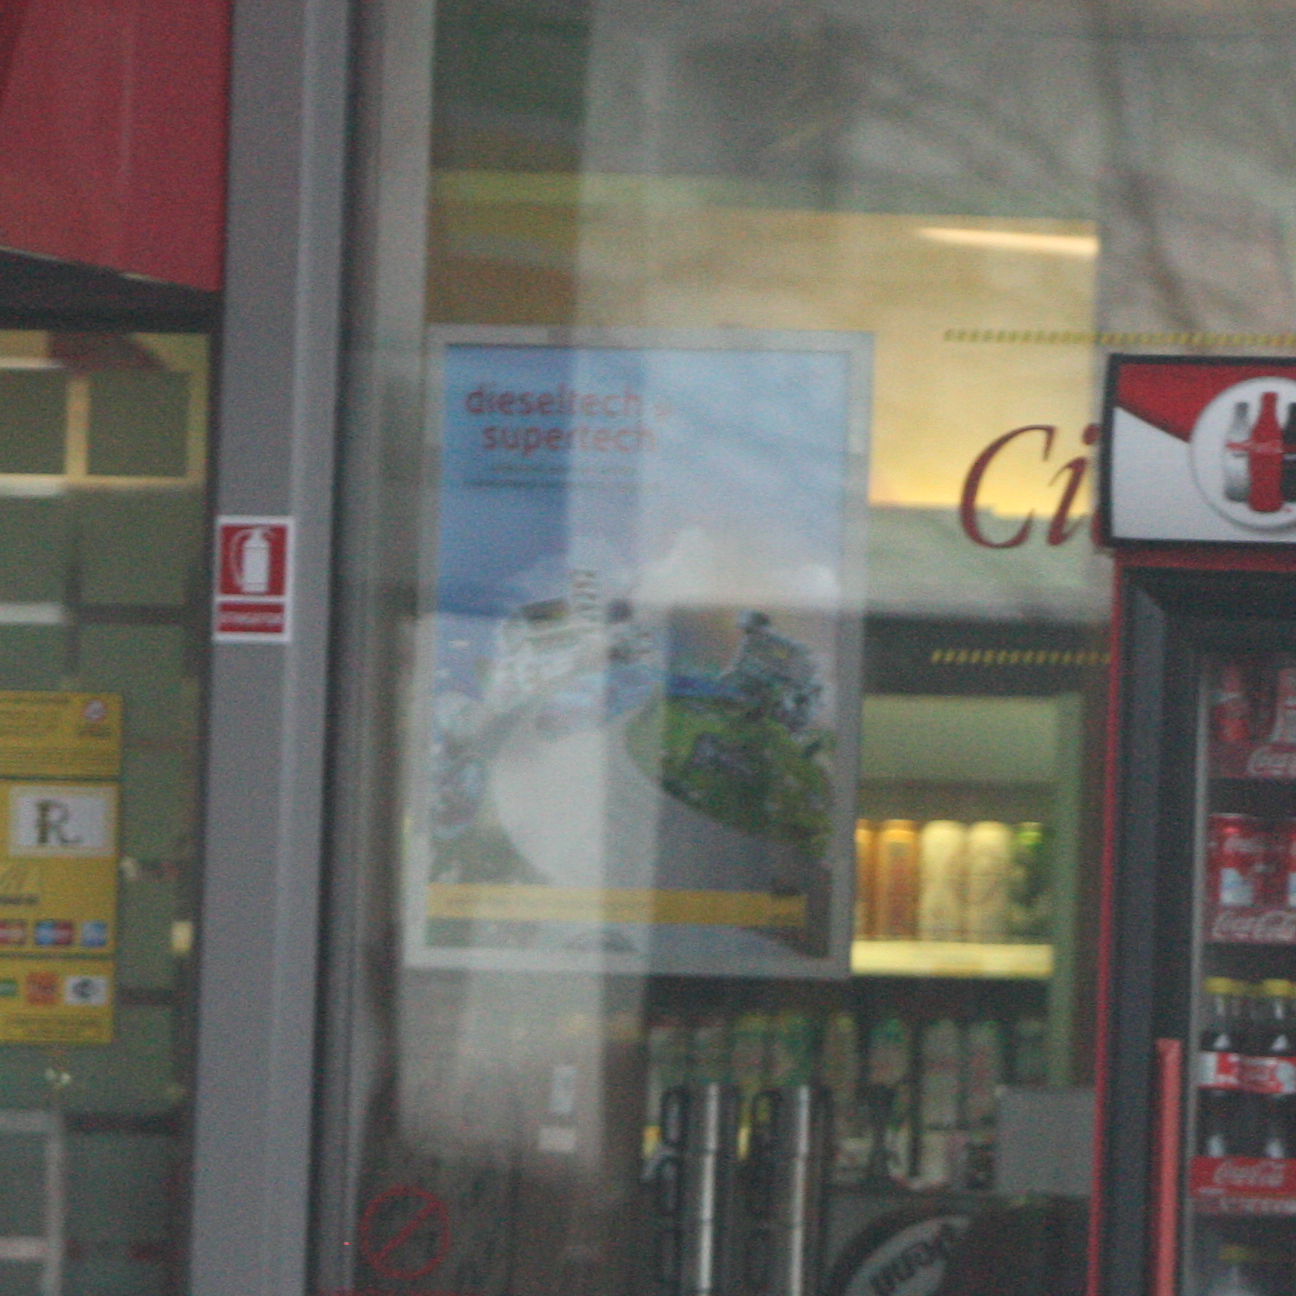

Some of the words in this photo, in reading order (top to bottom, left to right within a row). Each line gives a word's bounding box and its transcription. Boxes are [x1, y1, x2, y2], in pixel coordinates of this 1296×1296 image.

[465, 381, 642, 418] dieseltech
[482, 424, 655, 459] supertech
[960, 424, 1103, 550] Ci
